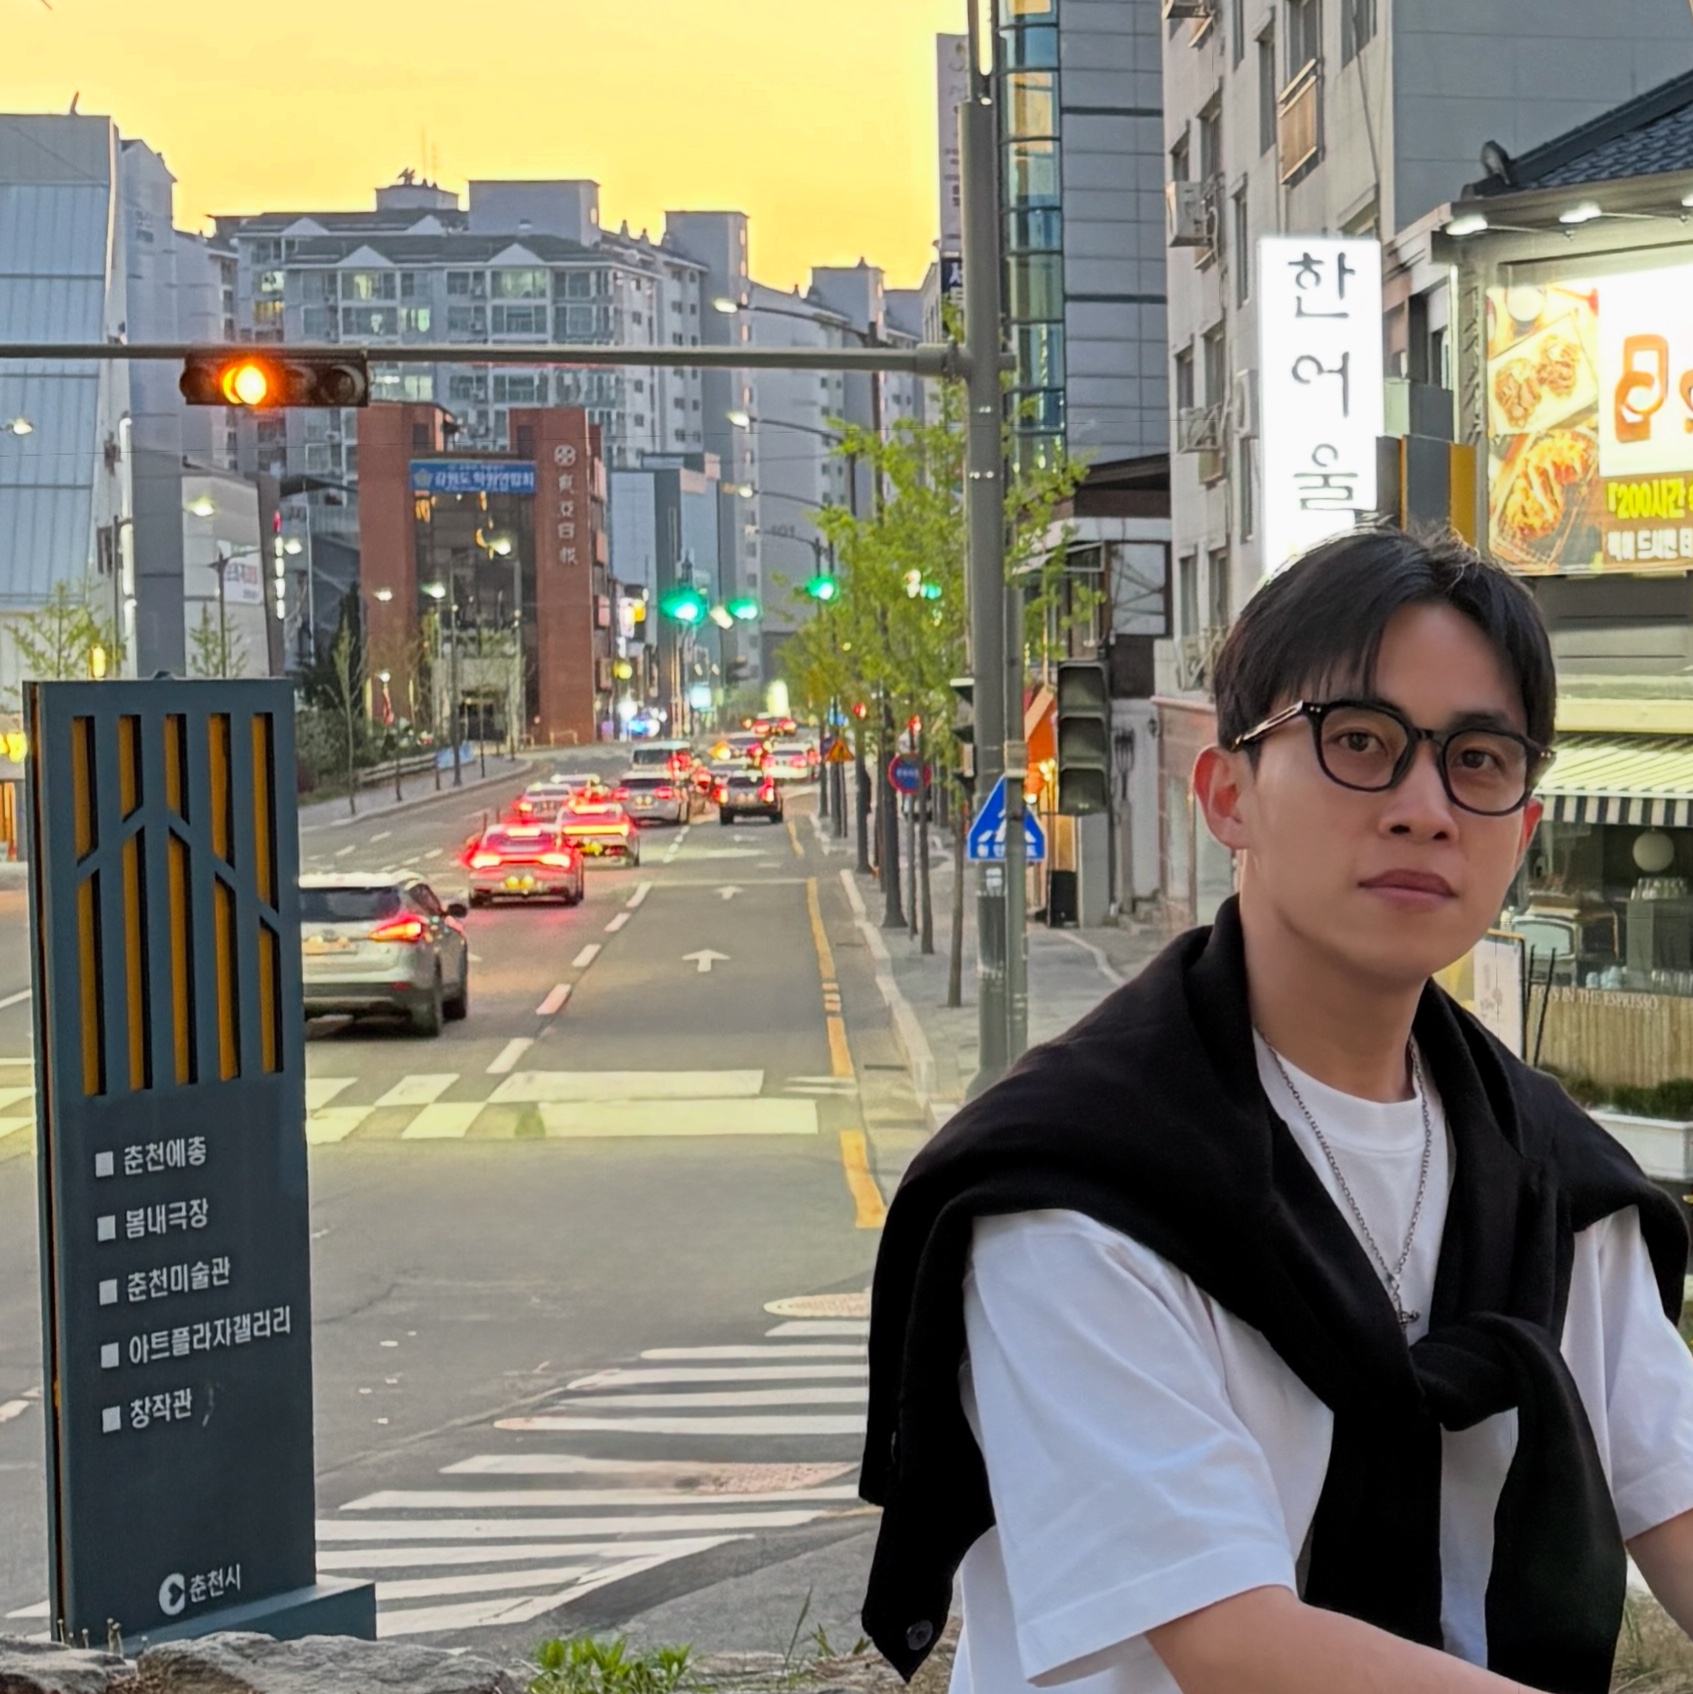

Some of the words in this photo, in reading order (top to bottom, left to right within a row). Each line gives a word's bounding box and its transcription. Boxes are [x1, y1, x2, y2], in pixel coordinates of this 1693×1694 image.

[1579, 988, 1599, 1006] THE
[1603, 990, 1658, 1010] ESPRESSO
[126, 1198, 208, 1239] 봄내극장
[127, 1256, 231, 1302] 춘천미술관
[129, 1305, 291, 1364] 아트플라자갤러리
[130, 1387, 193, 1429] 창작관
[189, 1563, 242, 1604] 춘천시
